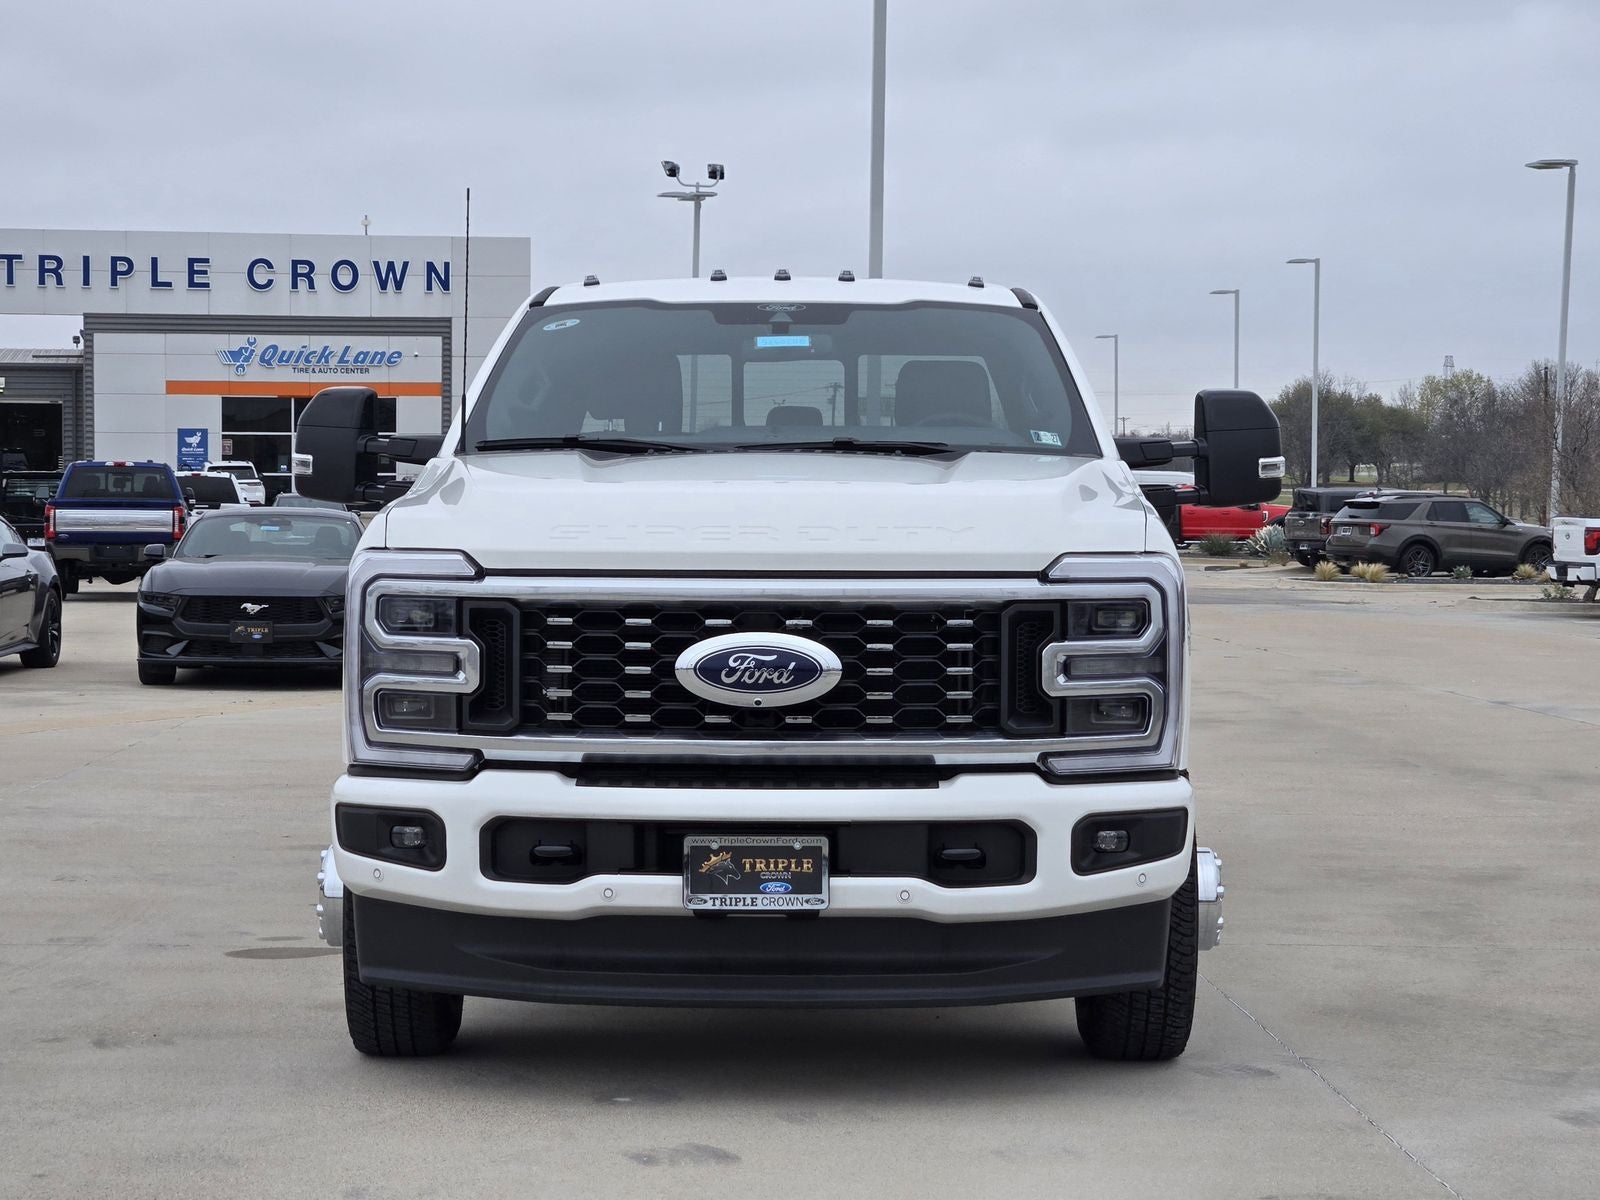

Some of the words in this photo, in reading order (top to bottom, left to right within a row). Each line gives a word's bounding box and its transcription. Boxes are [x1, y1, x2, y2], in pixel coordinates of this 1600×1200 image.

[0, 253, 211, 289] TRIPLE
[246, 257, 451, 293] CROWN
[258, 343, 336, 368] Quick
[335, 345, 403, 366] Lane
[548, 523, 780, 541] SUPER
[796, 525, 976, 542] DUTY
[720, 653, 796, 684] Ford
[742, 858, 813, 873] TRIPLE
[760, 871, 791, 879] CROWN
[709, 897, 758, 907] TRIPLE
[761, 897, 804, 907] CROWN
